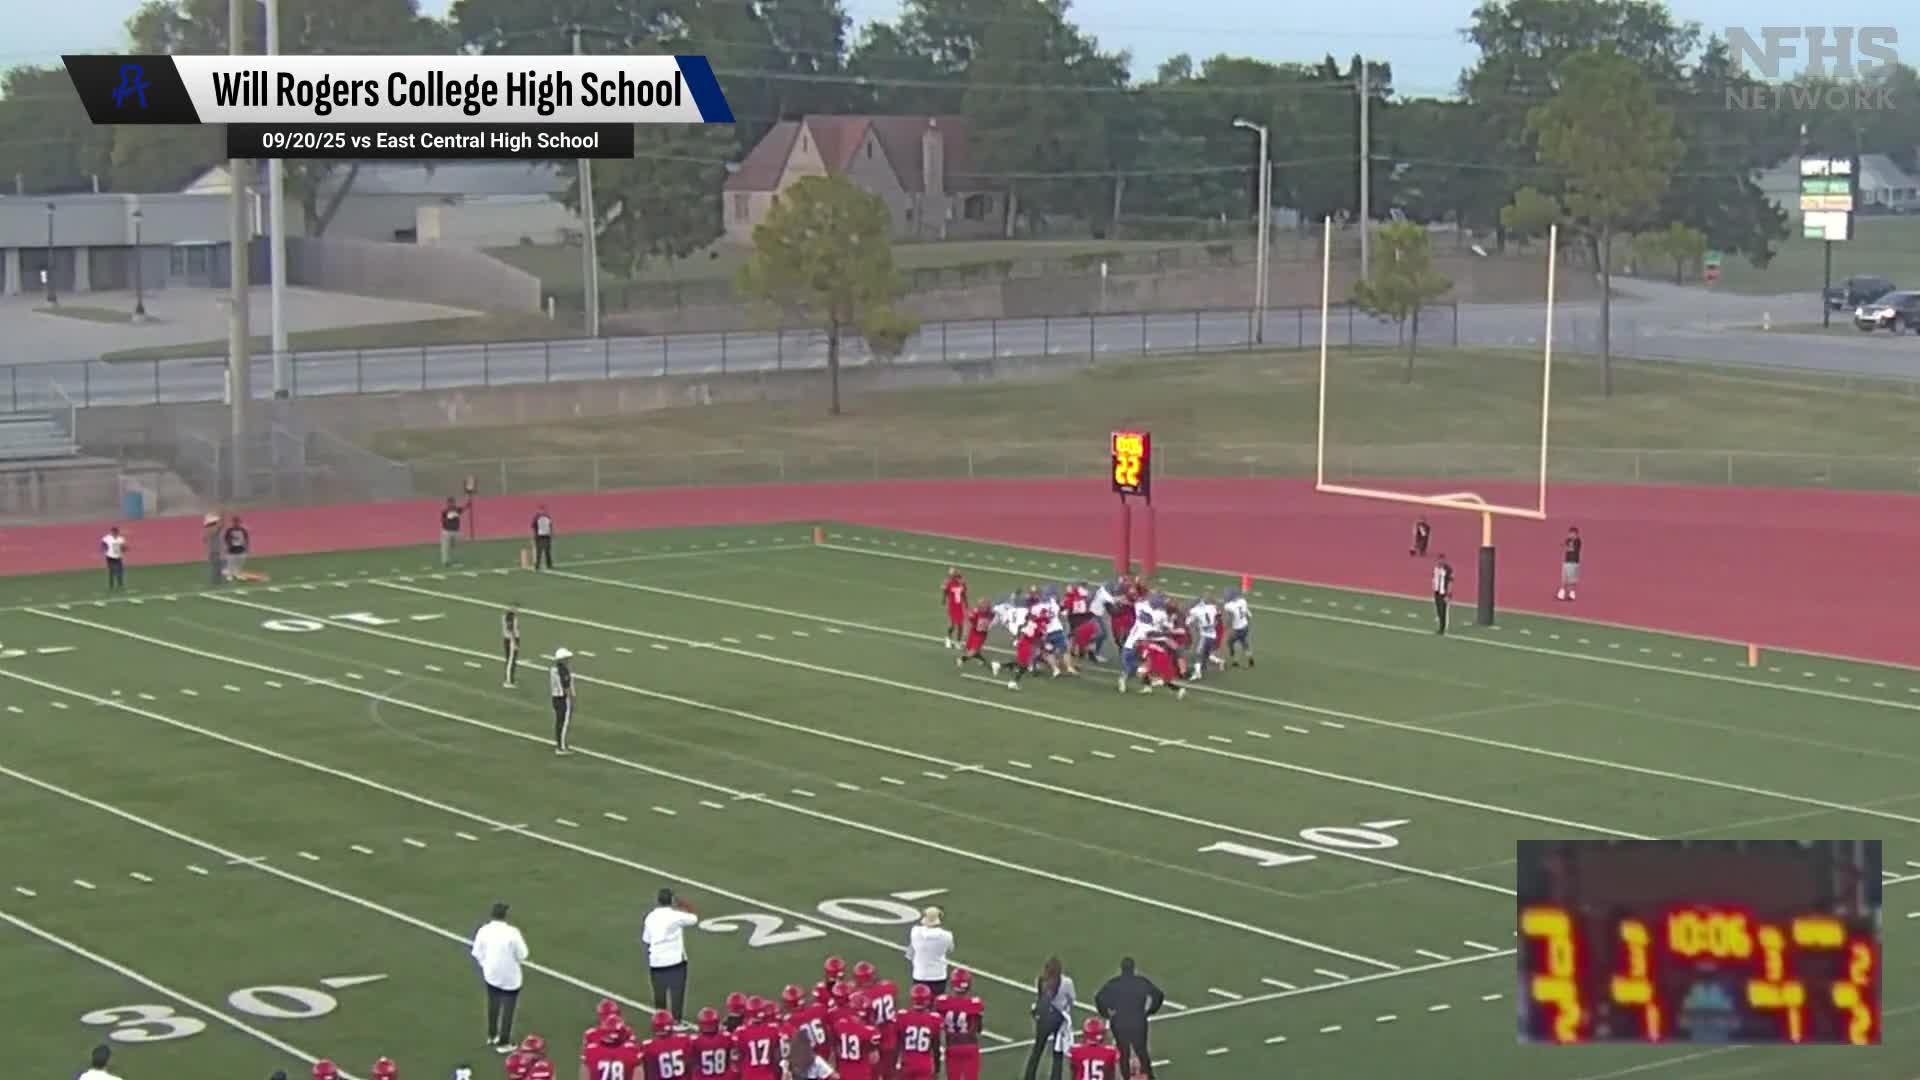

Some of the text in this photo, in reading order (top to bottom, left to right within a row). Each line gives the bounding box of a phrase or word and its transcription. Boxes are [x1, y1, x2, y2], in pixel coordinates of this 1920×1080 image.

[1198, 826, 1398, 867] 10
[699, 898, 921, 947] 20
[80, 985, 338, 1043] 30
[872, 993, 897, 1025] 72
[943, 1010, 969, 1034] 44
[748, 1038, 771, 1067] 17
[840, 1032, 861, 1061] 13
[905, 1025, 931, 1053] 26
[597, 1060, 625, 1080] 78
[658, 1049, 685, 1079] 65
[701, 1048, 727, 1076] 58
[1081, 1058, 1105, 1080] 15
